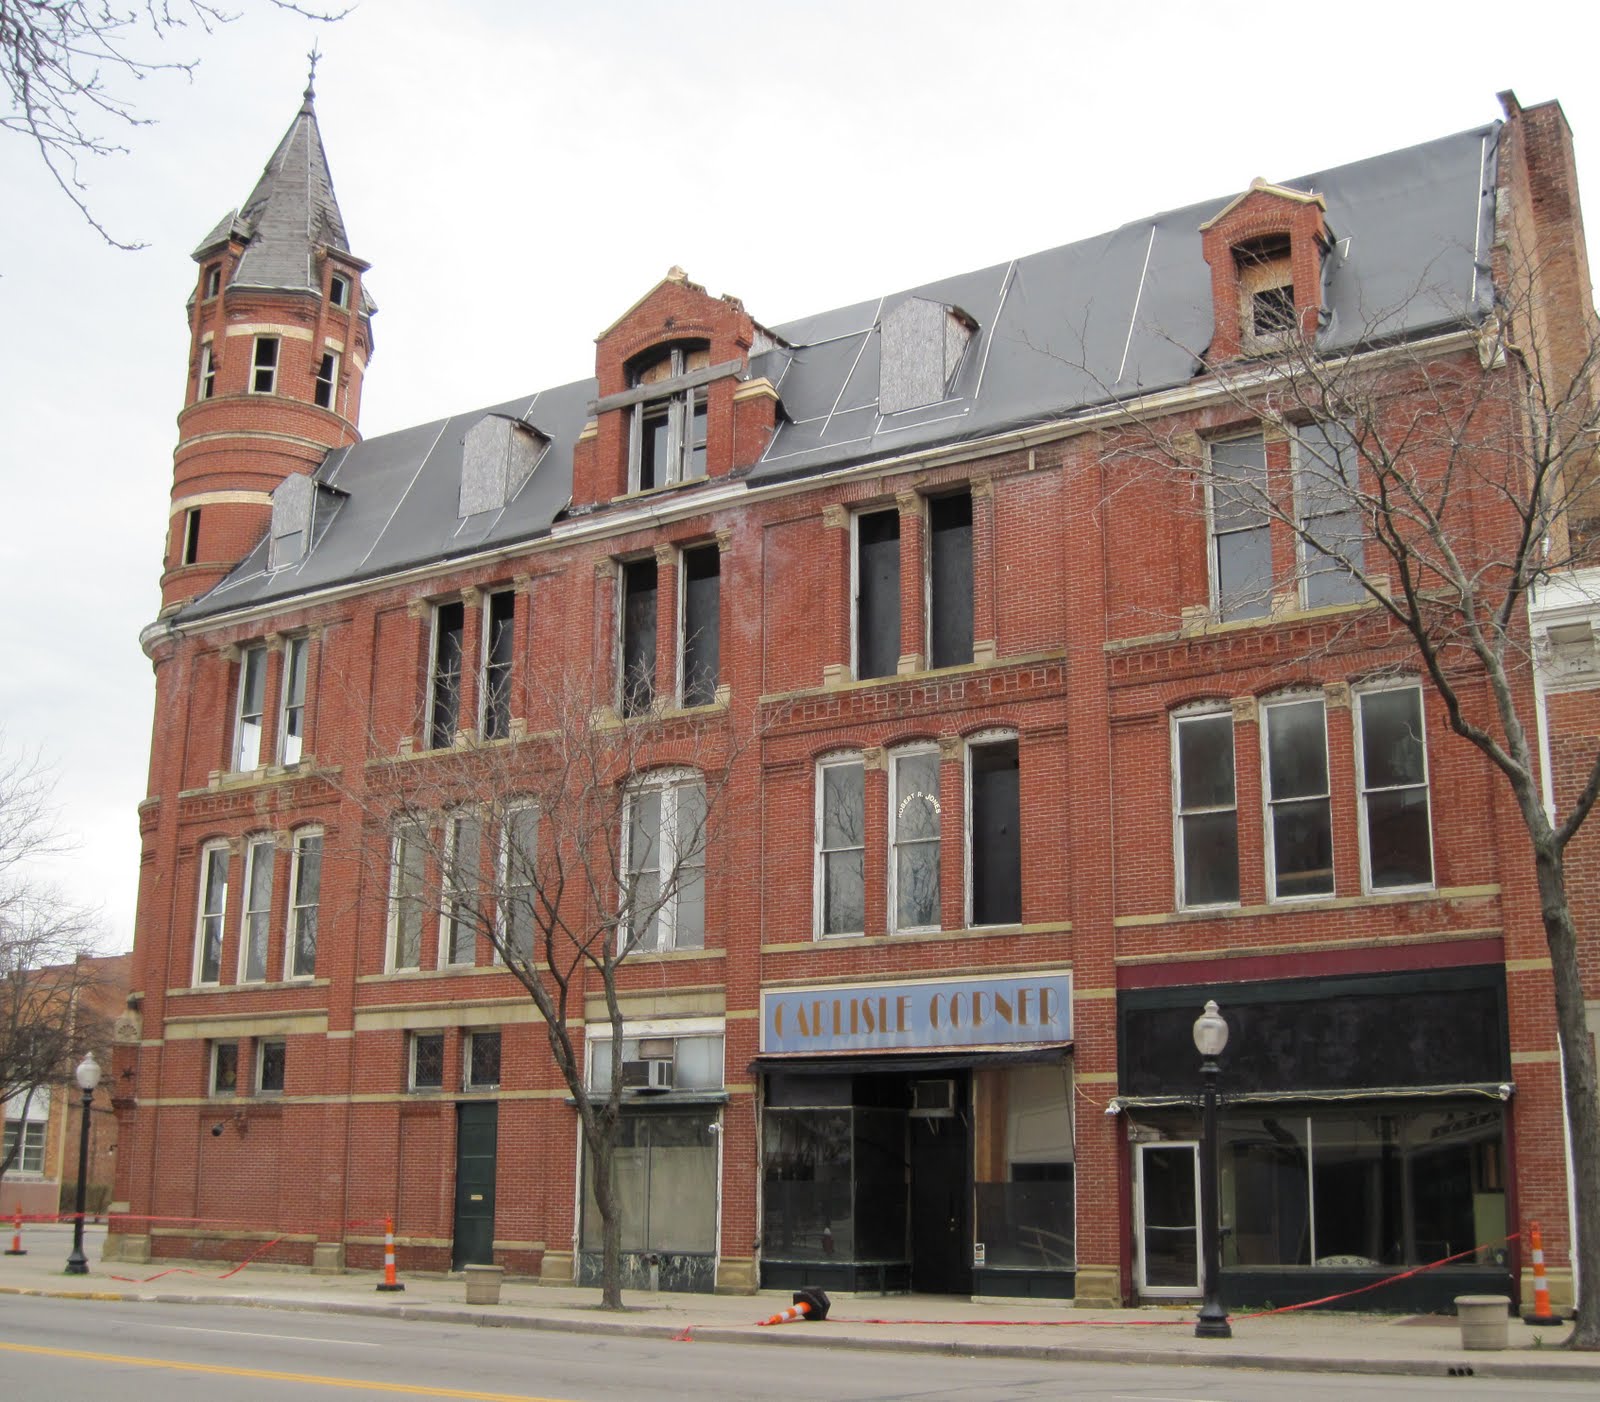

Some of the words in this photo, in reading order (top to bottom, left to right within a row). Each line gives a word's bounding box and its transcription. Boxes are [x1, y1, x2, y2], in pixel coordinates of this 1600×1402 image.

[925, 794, 941, 814] JONES
[774, 995, 912, 1037] CARLISLE
[929, 987, 1059, 1030] CORNER
